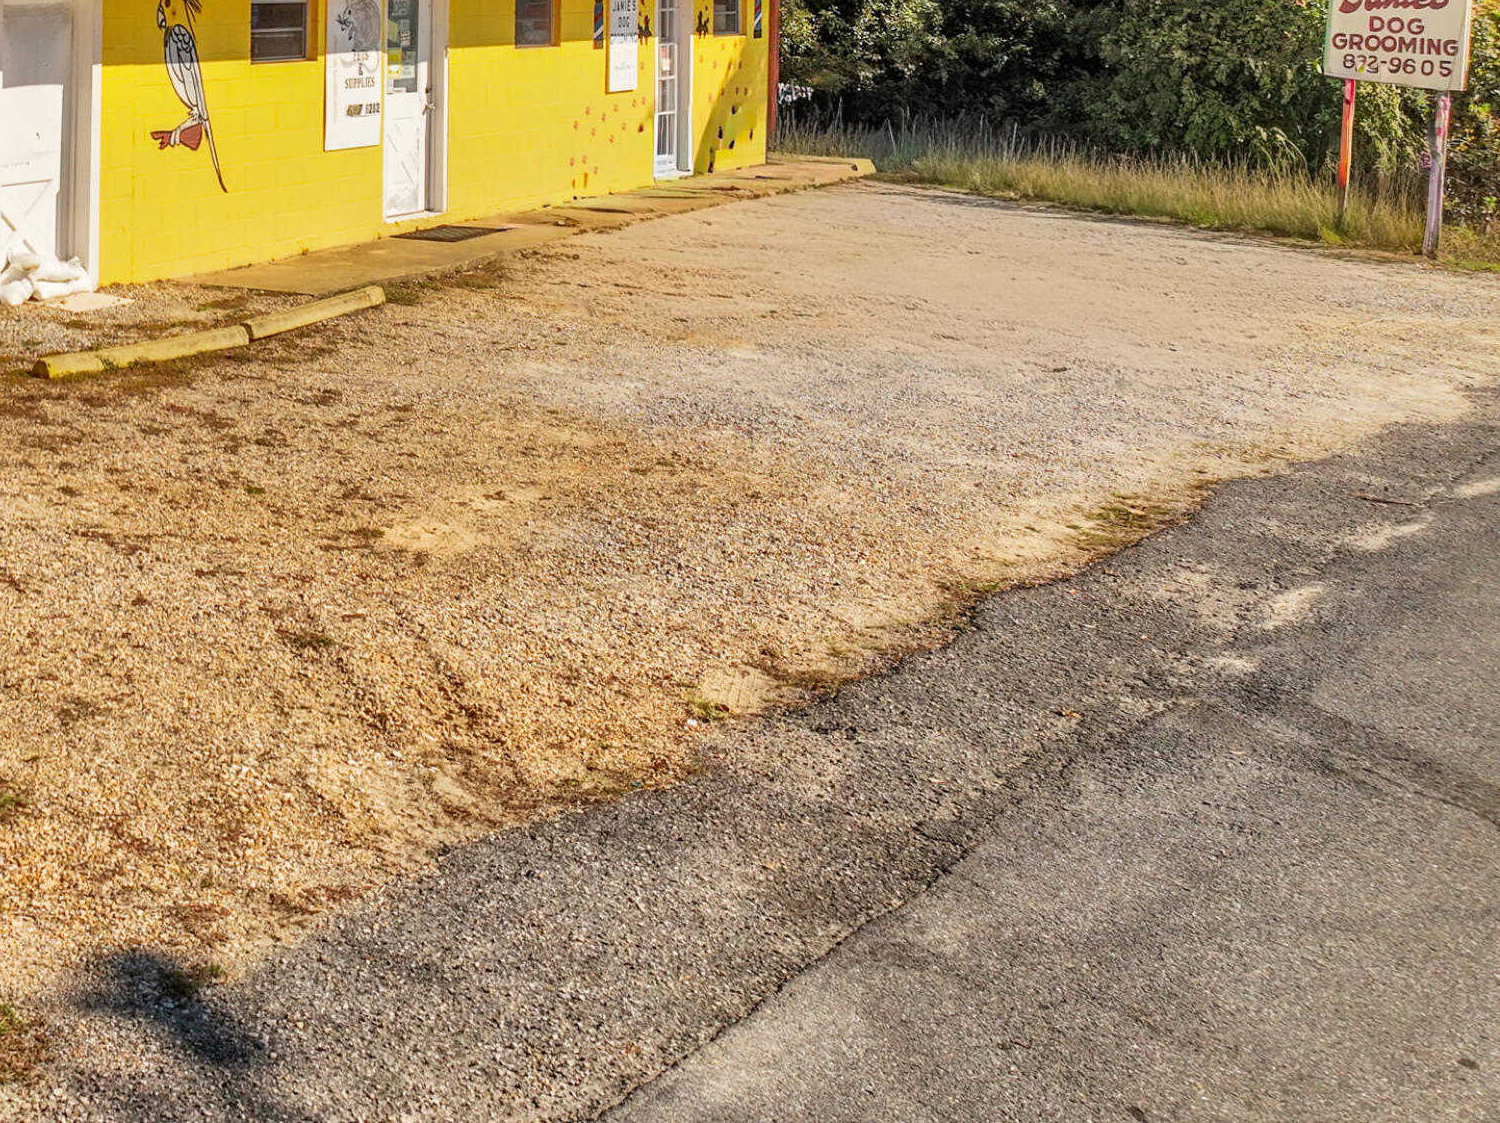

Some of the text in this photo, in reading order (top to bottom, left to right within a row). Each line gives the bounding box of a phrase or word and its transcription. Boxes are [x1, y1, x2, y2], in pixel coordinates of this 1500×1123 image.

[1369, 15, 1425, 35] DOG
[1332, 32, 1459, 57] GROOMING
[345, 77, 375, 89] SUPPLIES
